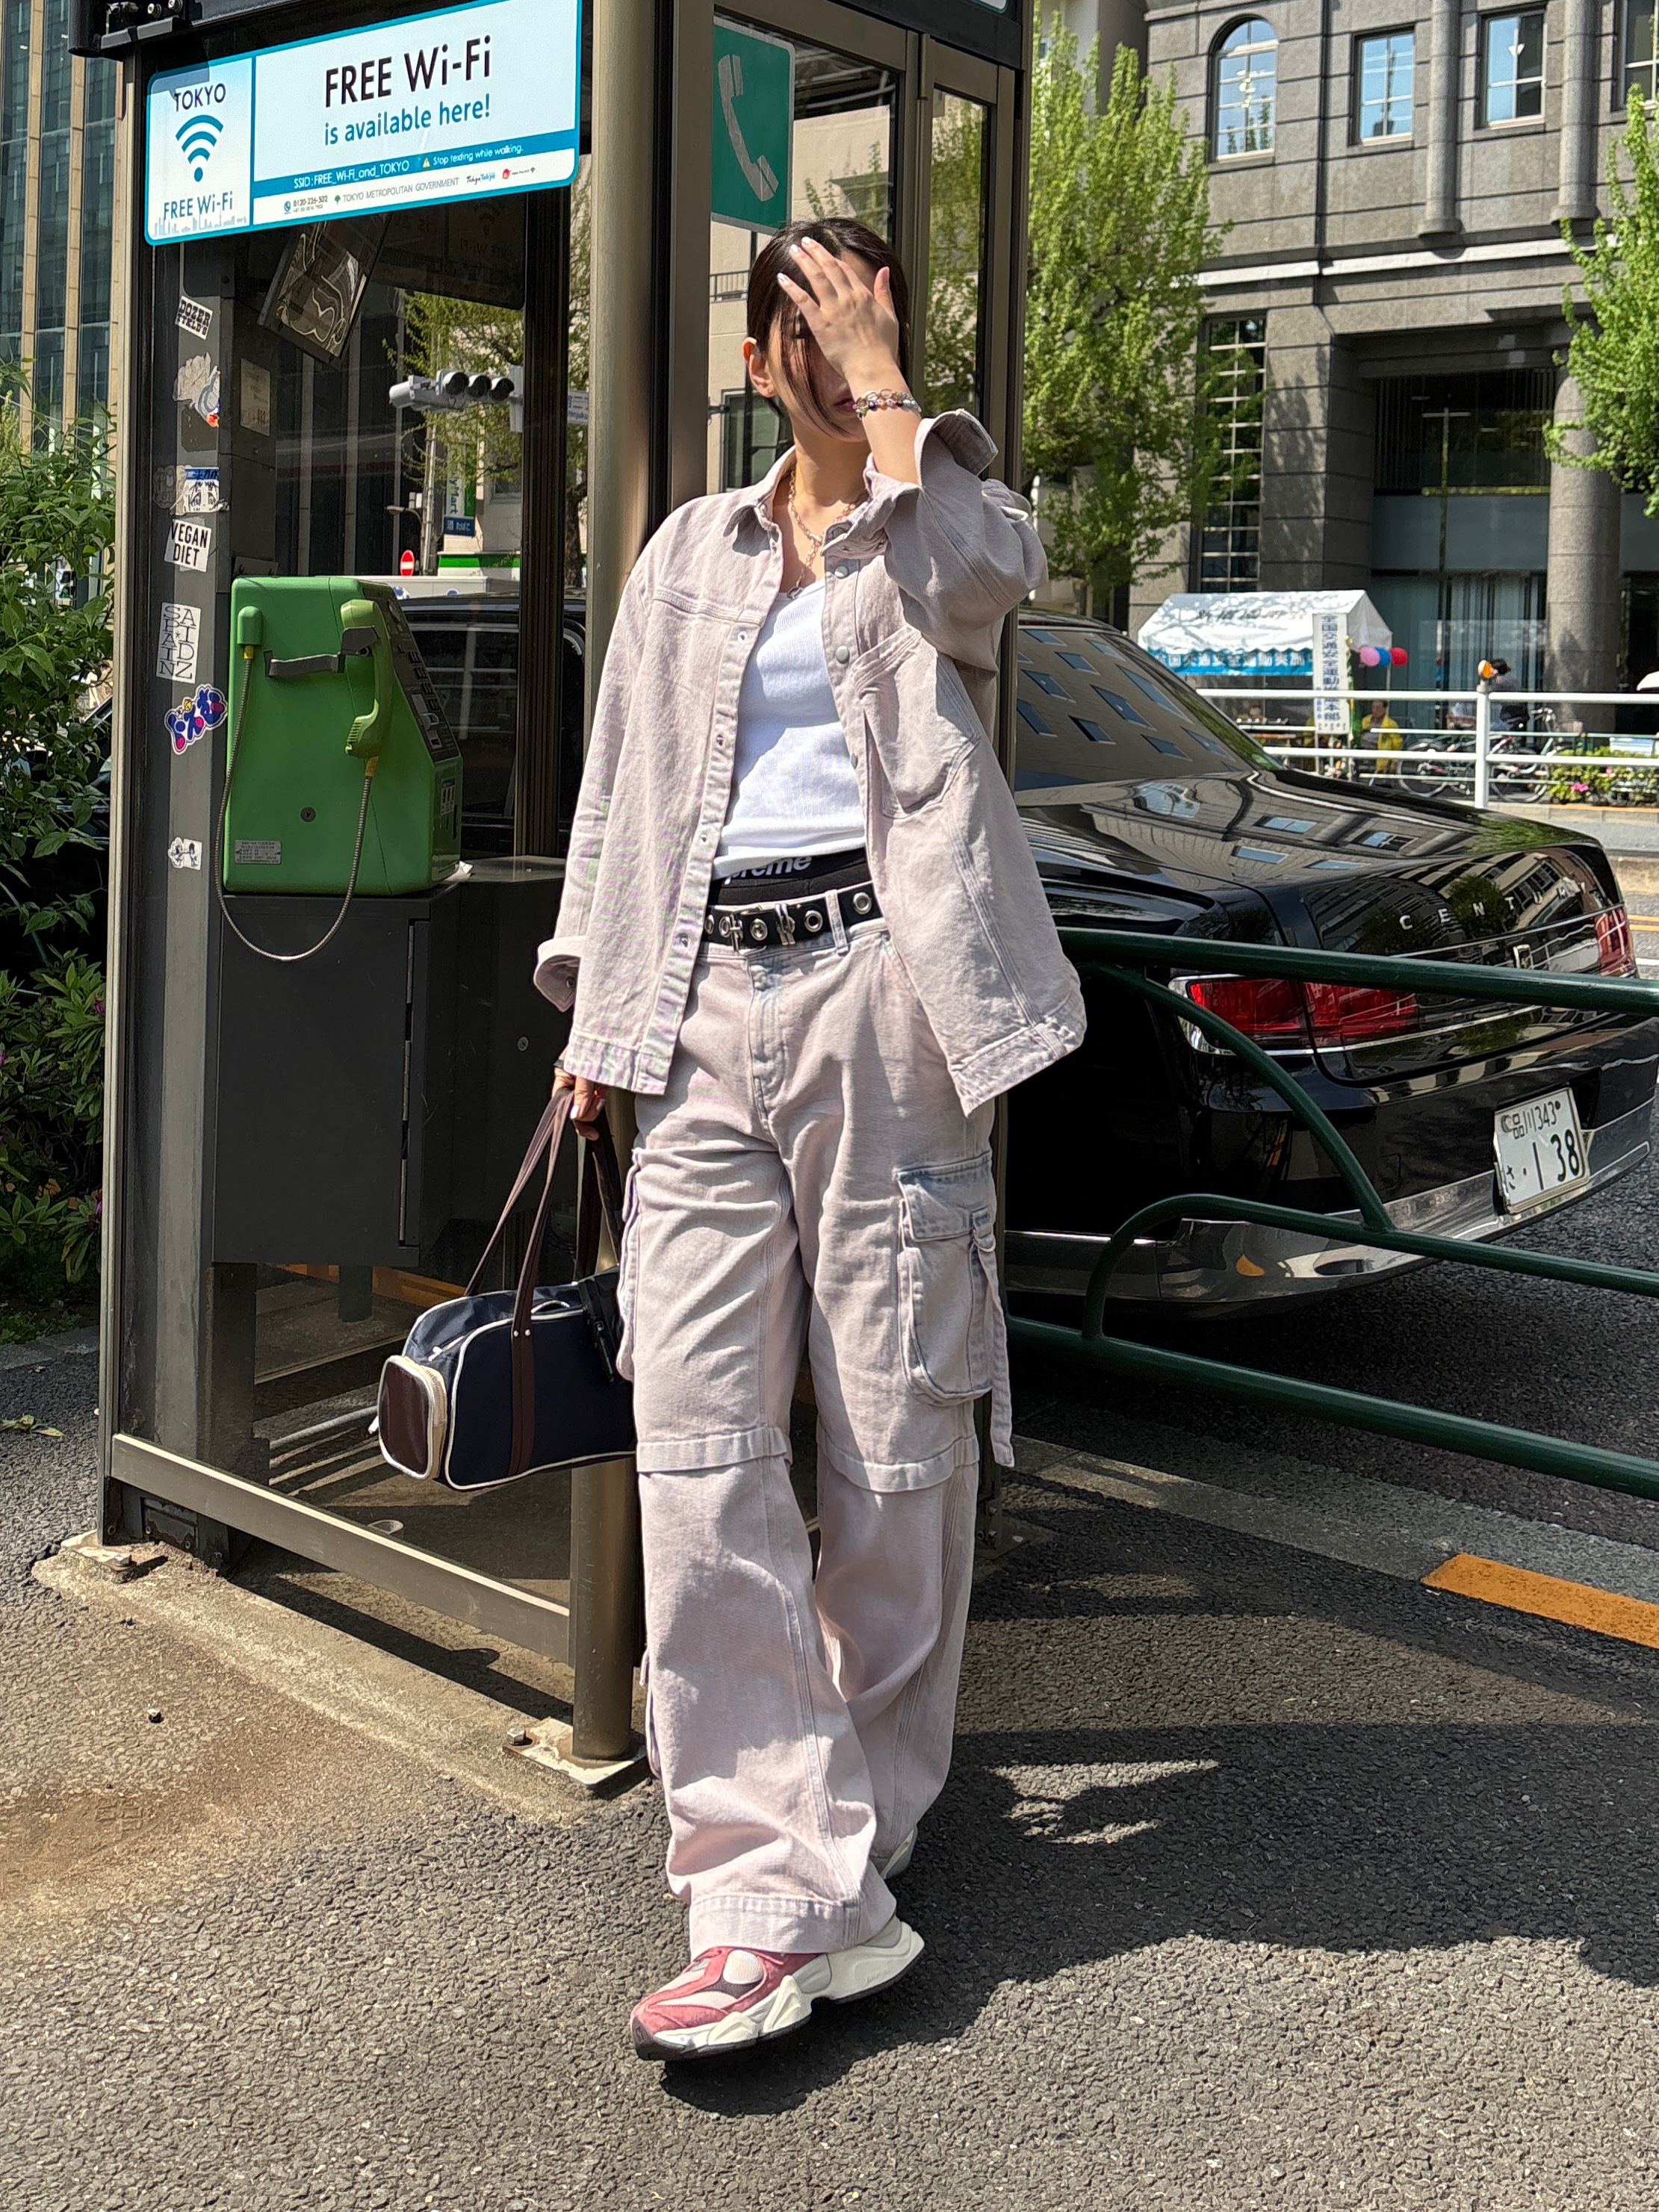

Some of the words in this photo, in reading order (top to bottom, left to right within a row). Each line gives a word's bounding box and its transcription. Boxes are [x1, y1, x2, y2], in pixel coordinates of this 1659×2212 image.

[325, 56, 392, 108] FREE
[403, 34, 491, 92] Wi-Fi
[173, 83, 226, 112] TOKYO
[325, 122, 338, 146] is
[344, 105, 432, 142] available
[439, 93, 490, 125] here!
[432, 156, 449, 166] Stop
[450, 152, 474, 163] texting
[475, 148, 493, 158] while
[343, 192, 364, 202] TOKYO
[366, 184, 413, 199] METROPOLITAN
[415, 177, 460, 191] GOVERNMENT
[163, 197, 193, 221] FREE
[197, 190, 233, 215] Wi-Fi
[179, 299, 211, 327] DOZER
[170, 521, 208, 548] VEGAN
[173, 543, 200, 567] DIET
